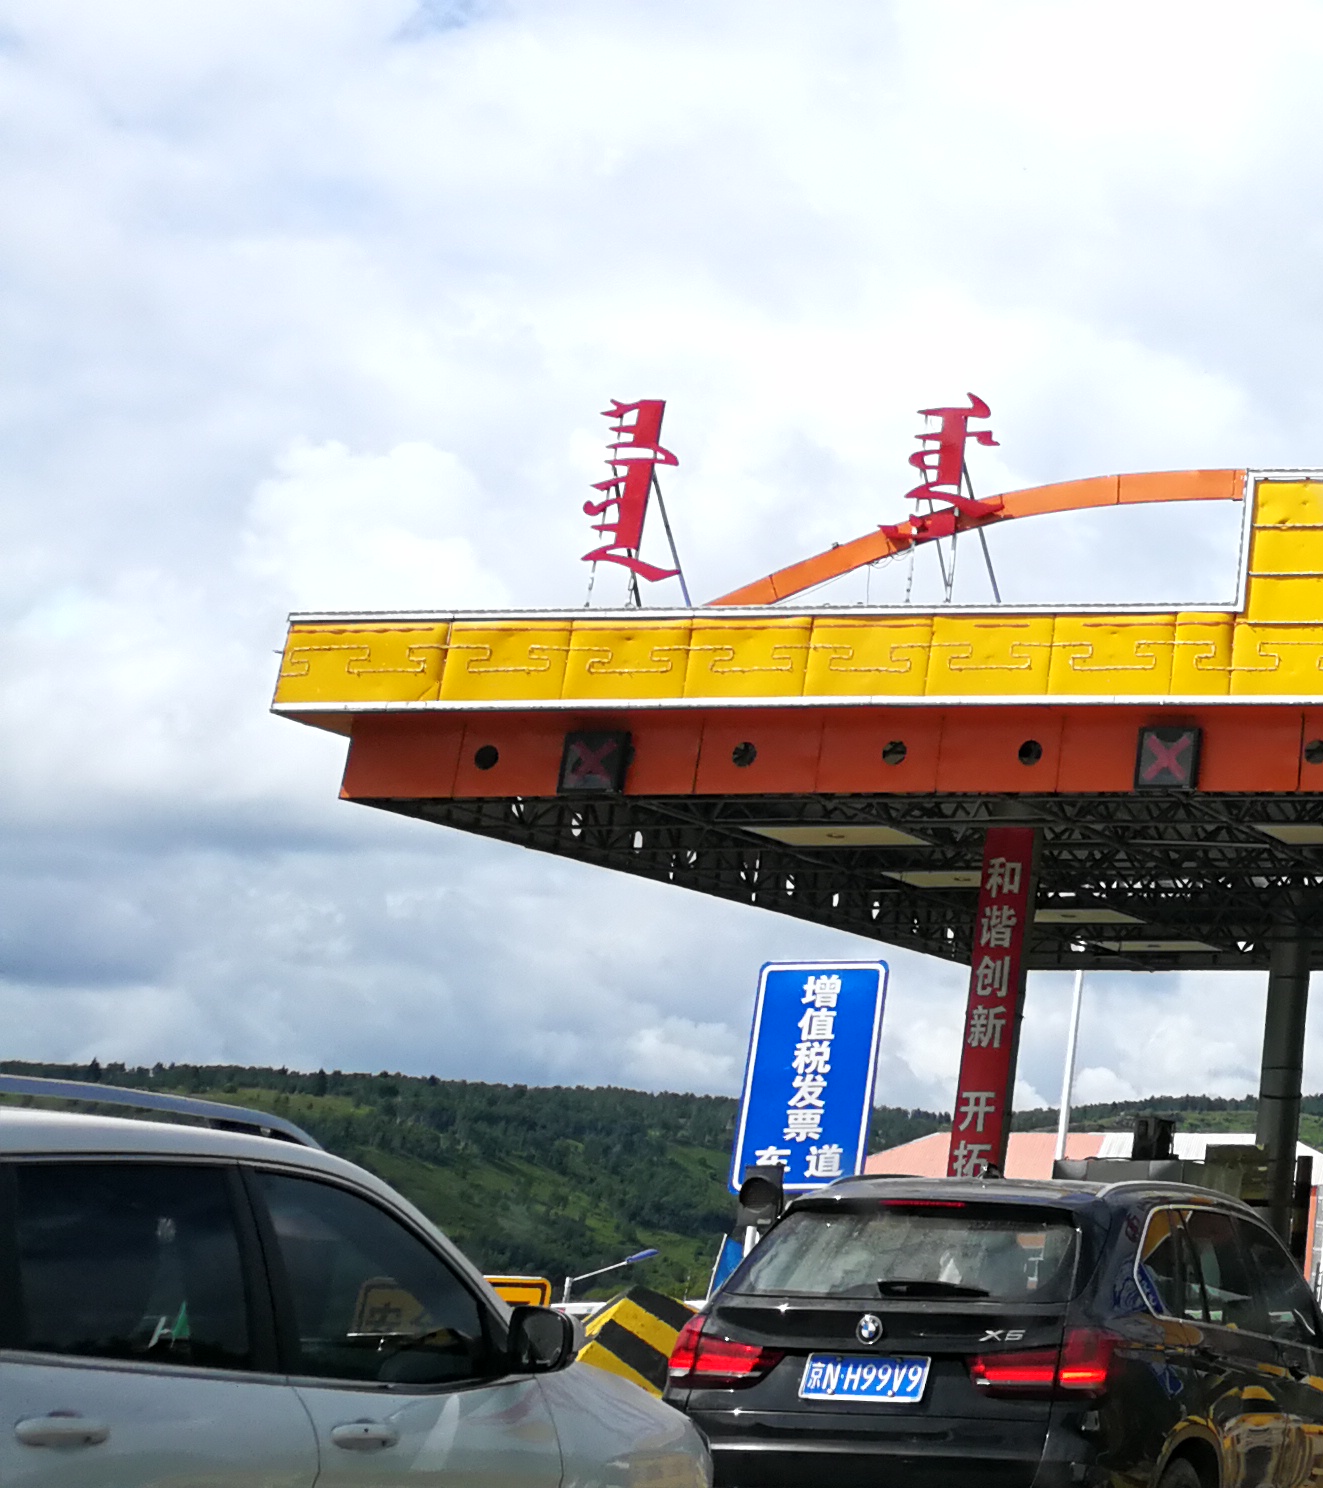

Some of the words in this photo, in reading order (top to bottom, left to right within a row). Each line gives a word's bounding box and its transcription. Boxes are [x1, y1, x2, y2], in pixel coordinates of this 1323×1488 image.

[966, 856, 1022, 1050] 和谐创新
[782, 974, 842, 1143] 增值税发票
[754, 1143, 844, 1178] 车道
[952, 1090, 996, 1178] 开拓
